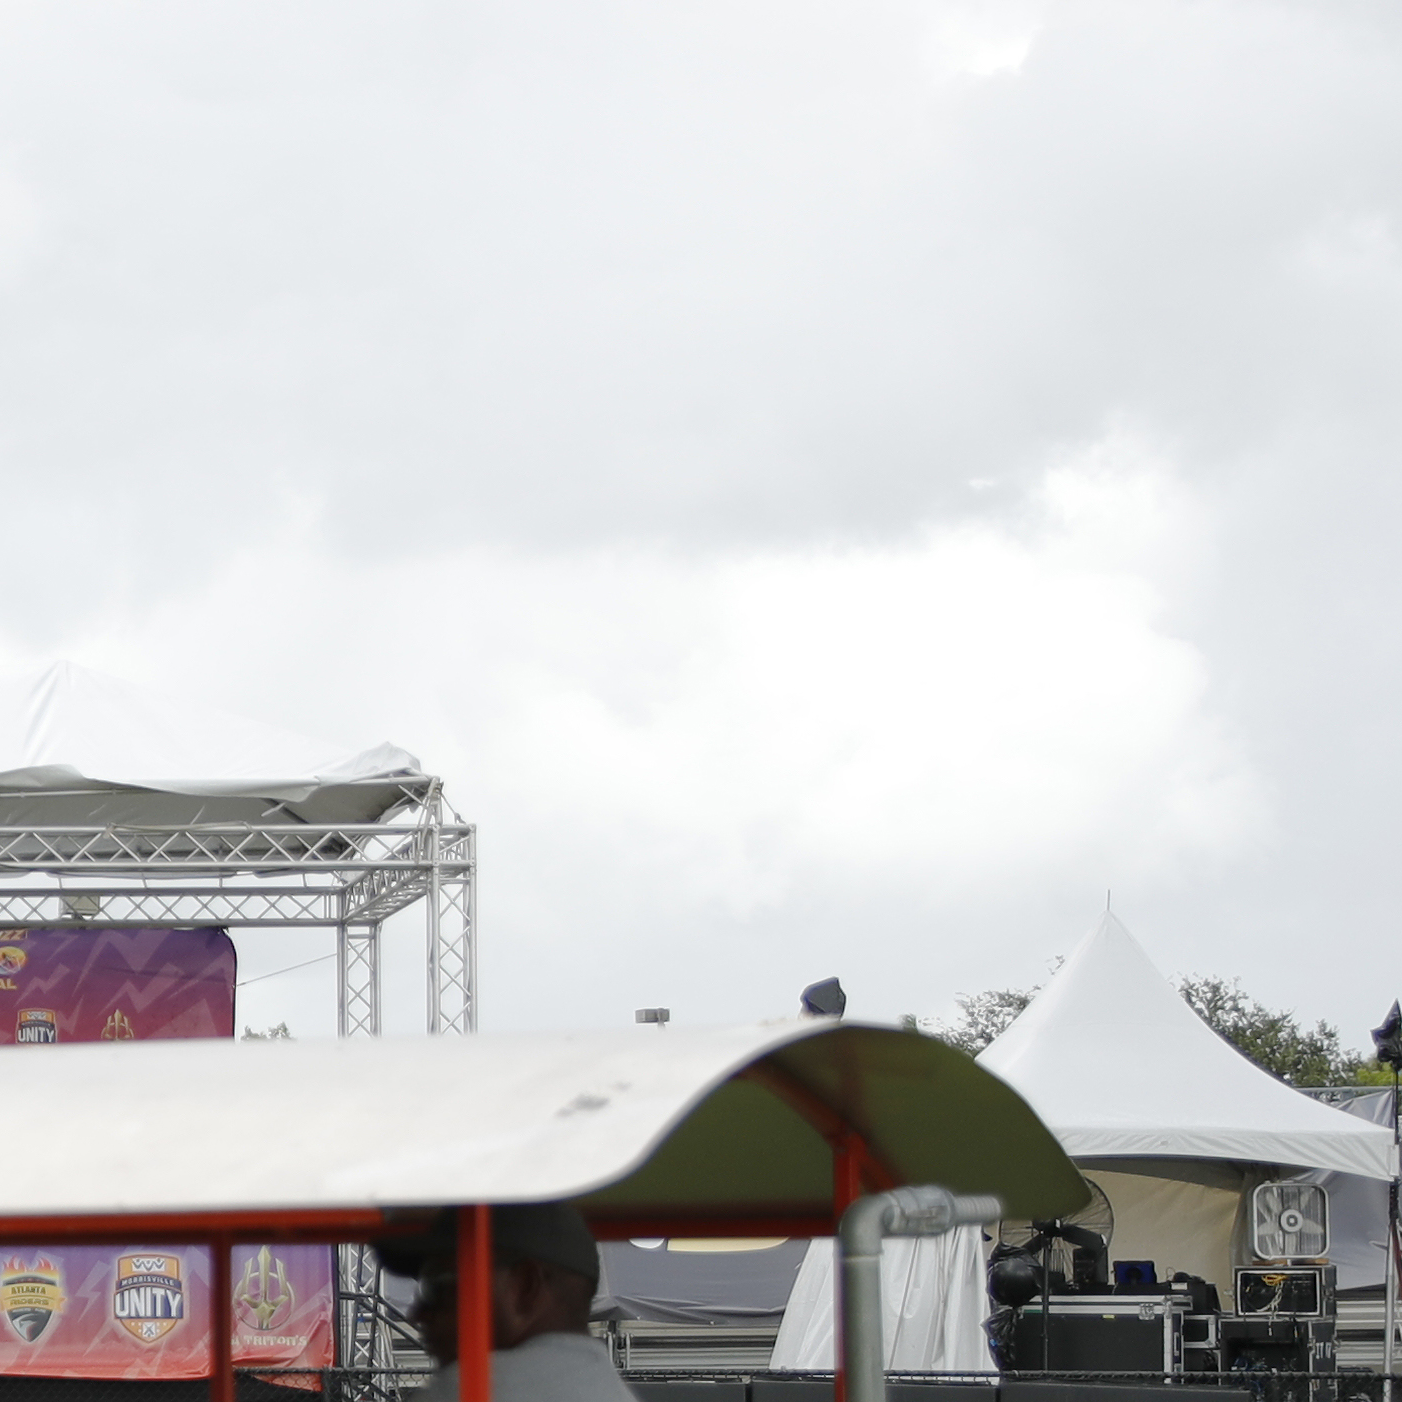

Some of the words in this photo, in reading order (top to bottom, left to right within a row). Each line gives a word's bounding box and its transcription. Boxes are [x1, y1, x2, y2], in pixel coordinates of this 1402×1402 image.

[18, 1026, 55, 1043] UNITY
[11, 1285, 46, 1295] ATLANTA
[115, 1287, 182, 1318] UNITY
